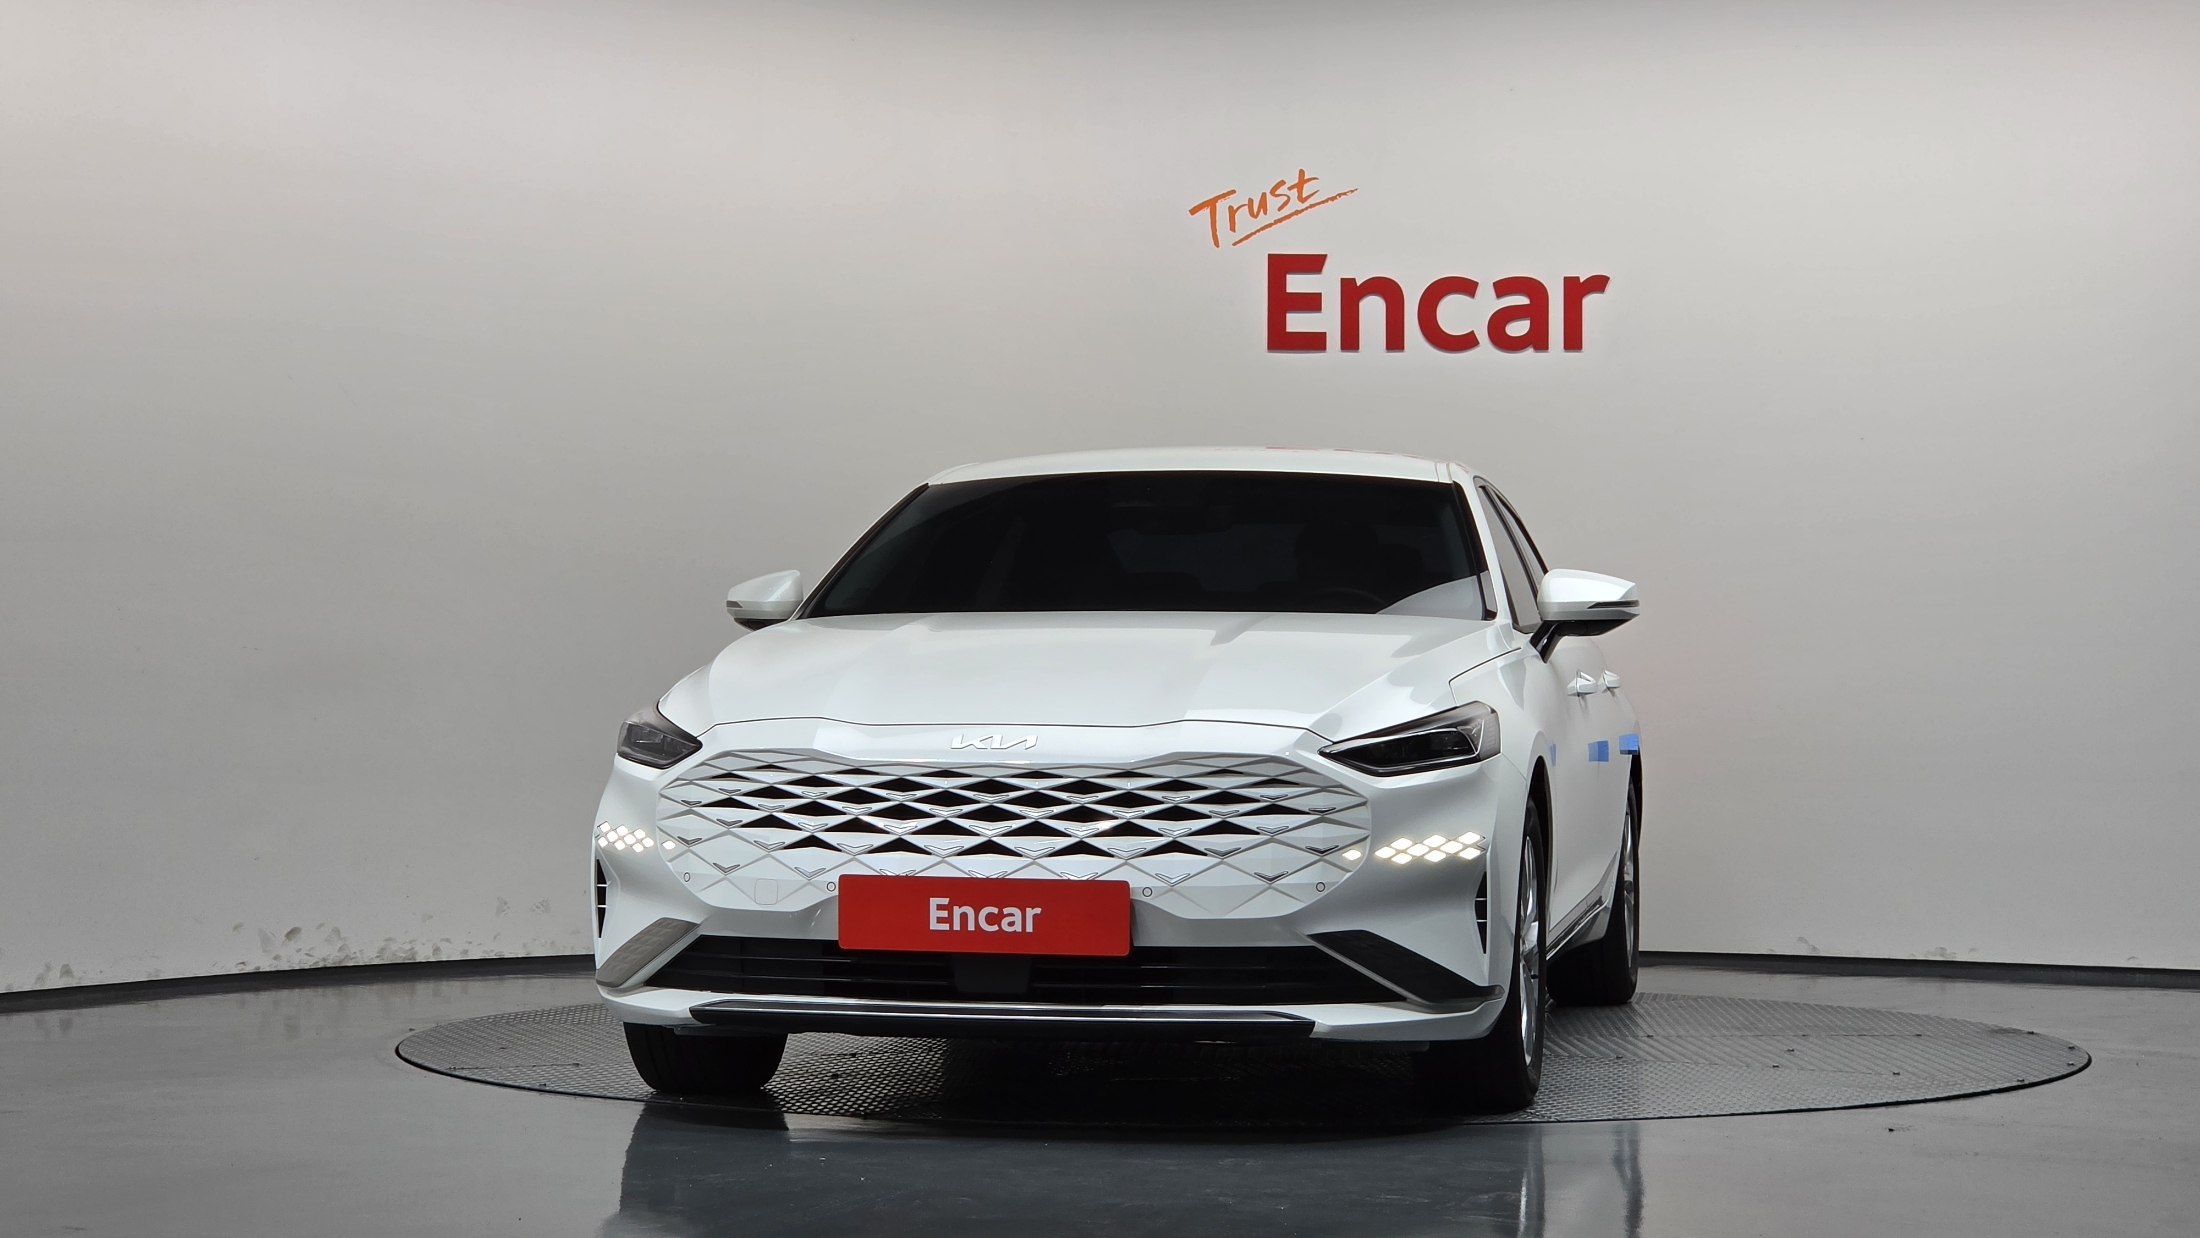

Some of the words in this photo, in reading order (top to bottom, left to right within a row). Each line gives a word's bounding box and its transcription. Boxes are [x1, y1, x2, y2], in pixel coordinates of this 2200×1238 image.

[1189, 168, 1320, 249] Trust
[1266, 253, 1611, 352] Encar
[950, 733, 1039, 751] KIA
[928, 897, 1043, 933] Encar
